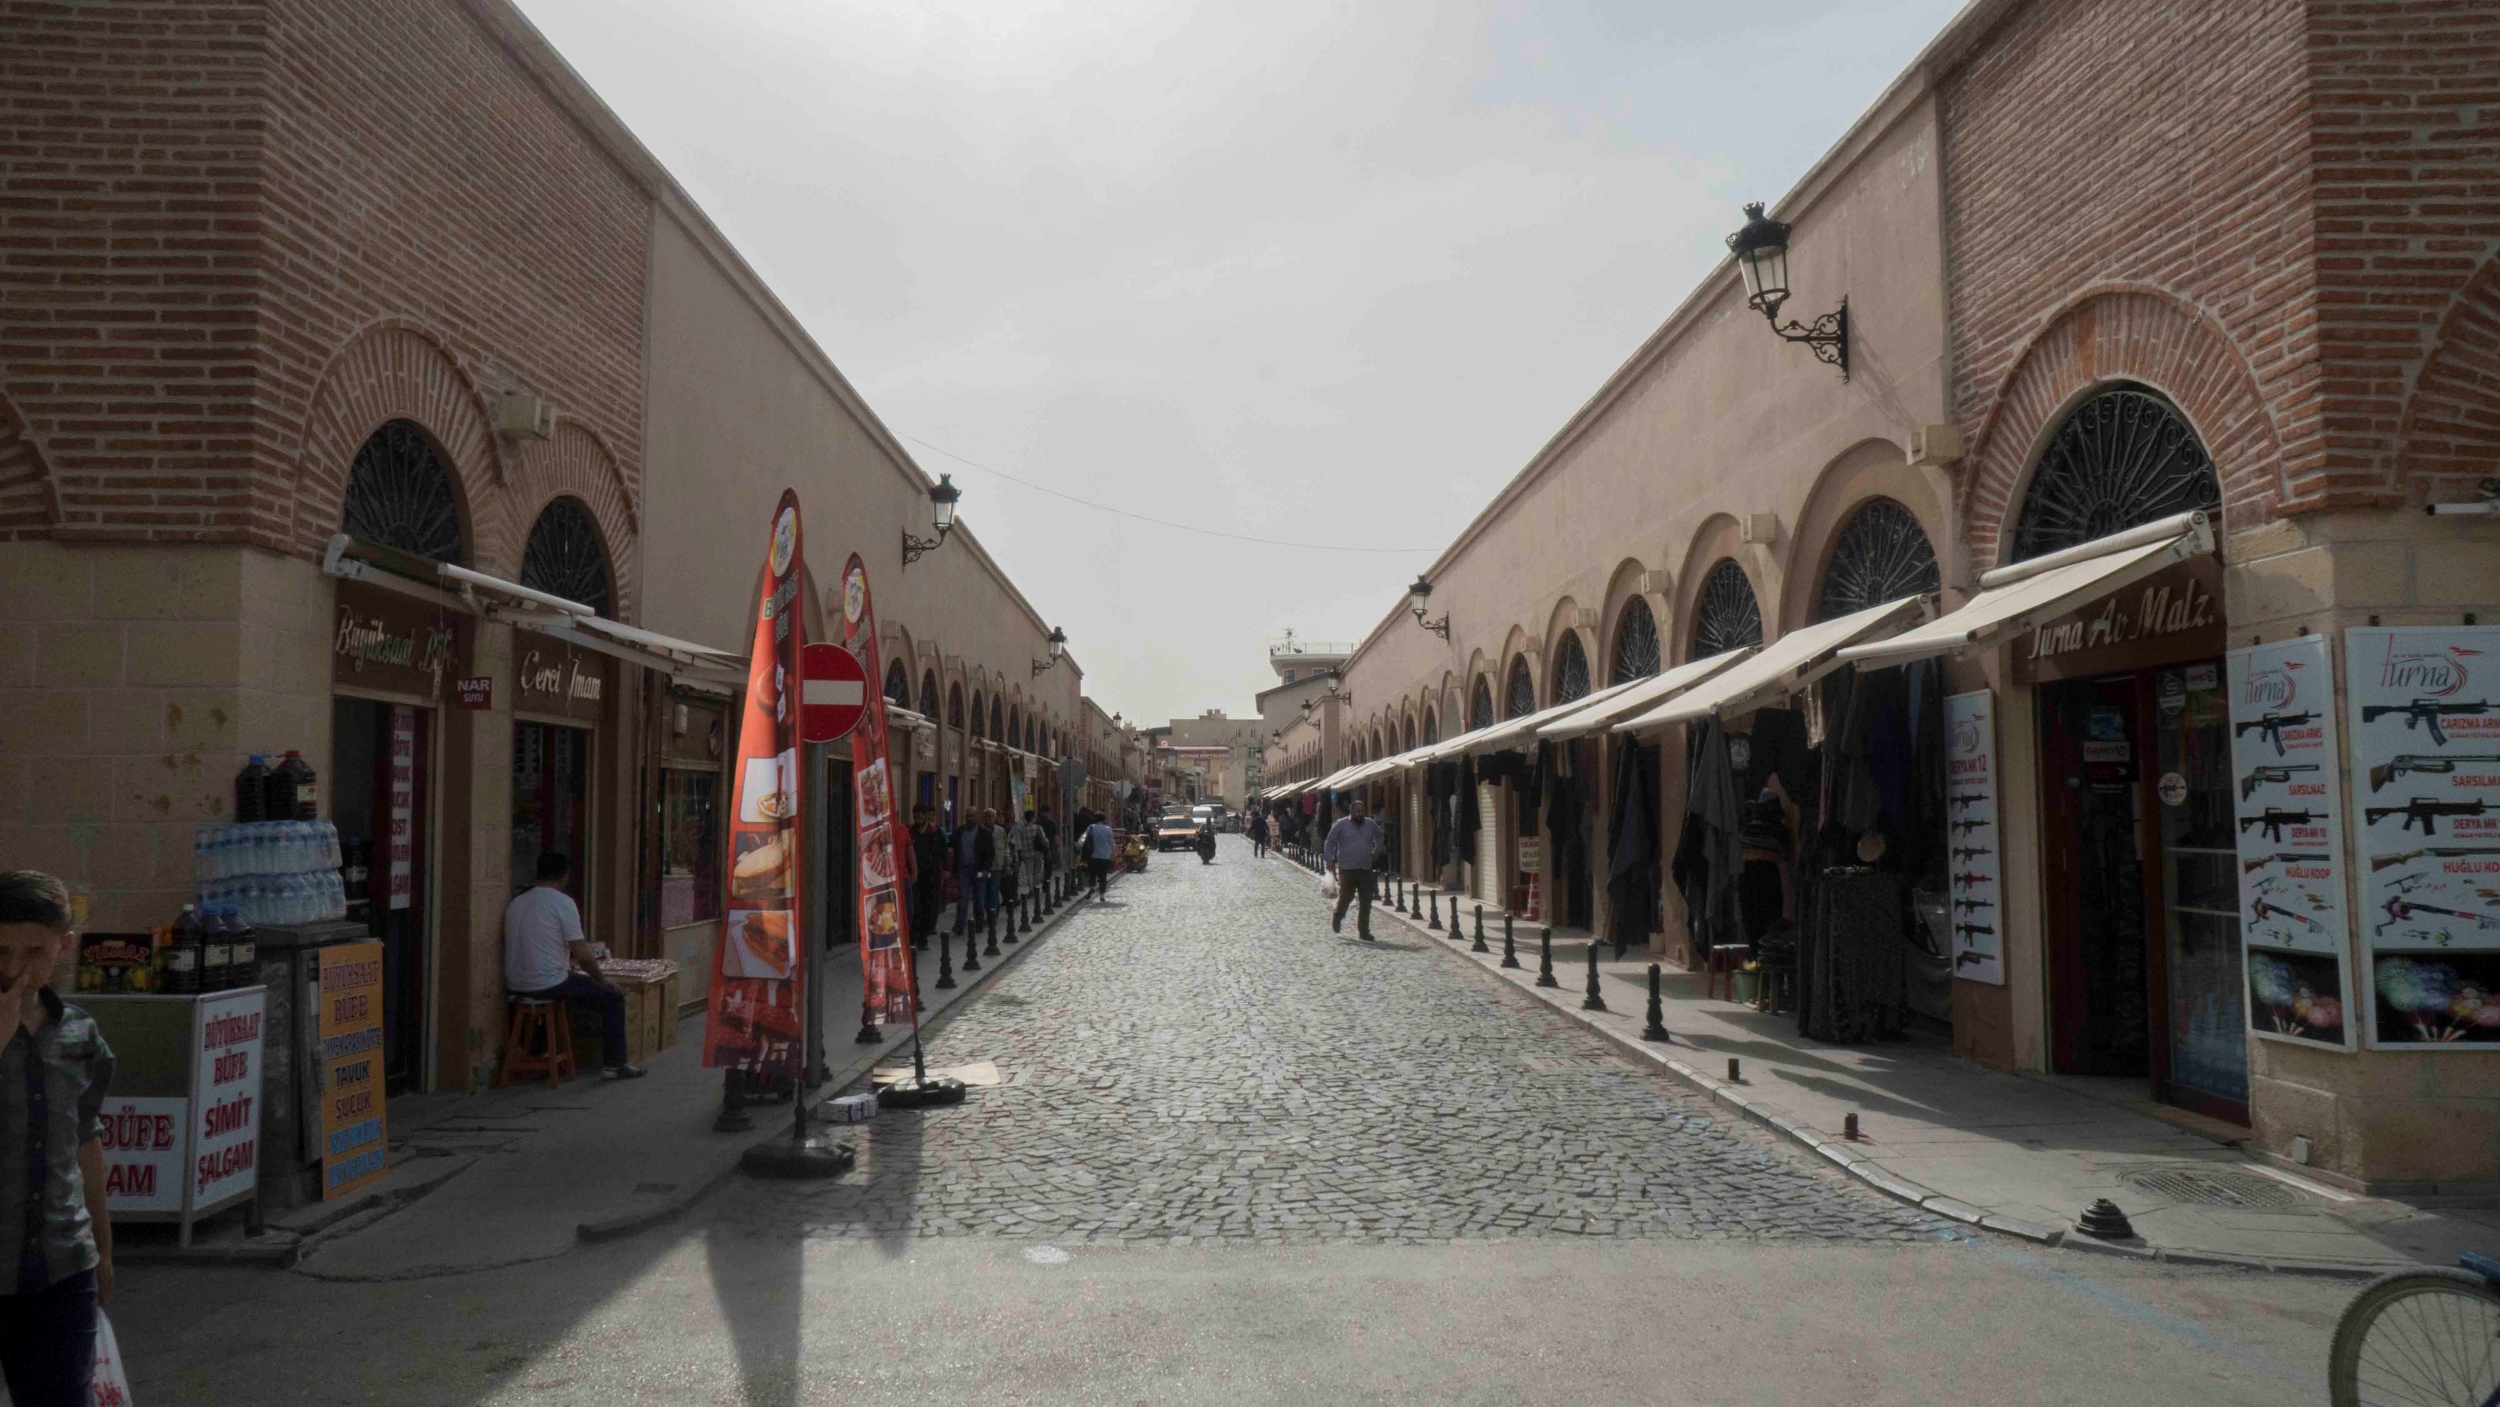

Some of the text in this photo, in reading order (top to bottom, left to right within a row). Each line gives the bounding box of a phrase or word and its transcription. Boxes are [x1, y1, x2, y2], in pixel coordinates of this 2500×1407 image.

[2086, 597, 2130, 648] Av
[2129, 578, 2214, 640] Malz.
[457, 679, 490, 692] NAR
[463, 693, 484, 703] SUYU
[2482, 717, 2500, 729] ARM
[2484, 861, 2500, 873] KO
[333, 991, 369, 1024] BÜFE
[203, 1012, 261, 1051] BÜYÜKSAAT
[213, 1048, 247, 1085] BÜFE
[334, 1059, 370, 1087] TAVUK
[204, 1091, 253, 1139] SİMİT
[335, 1090, 371, 1121] SUCUK
[101, 1106, 174, 1151] BÜFE
[105, 1163, 157, 1197] AM
[198, 1140, 254, 1195] ŞALGAM
